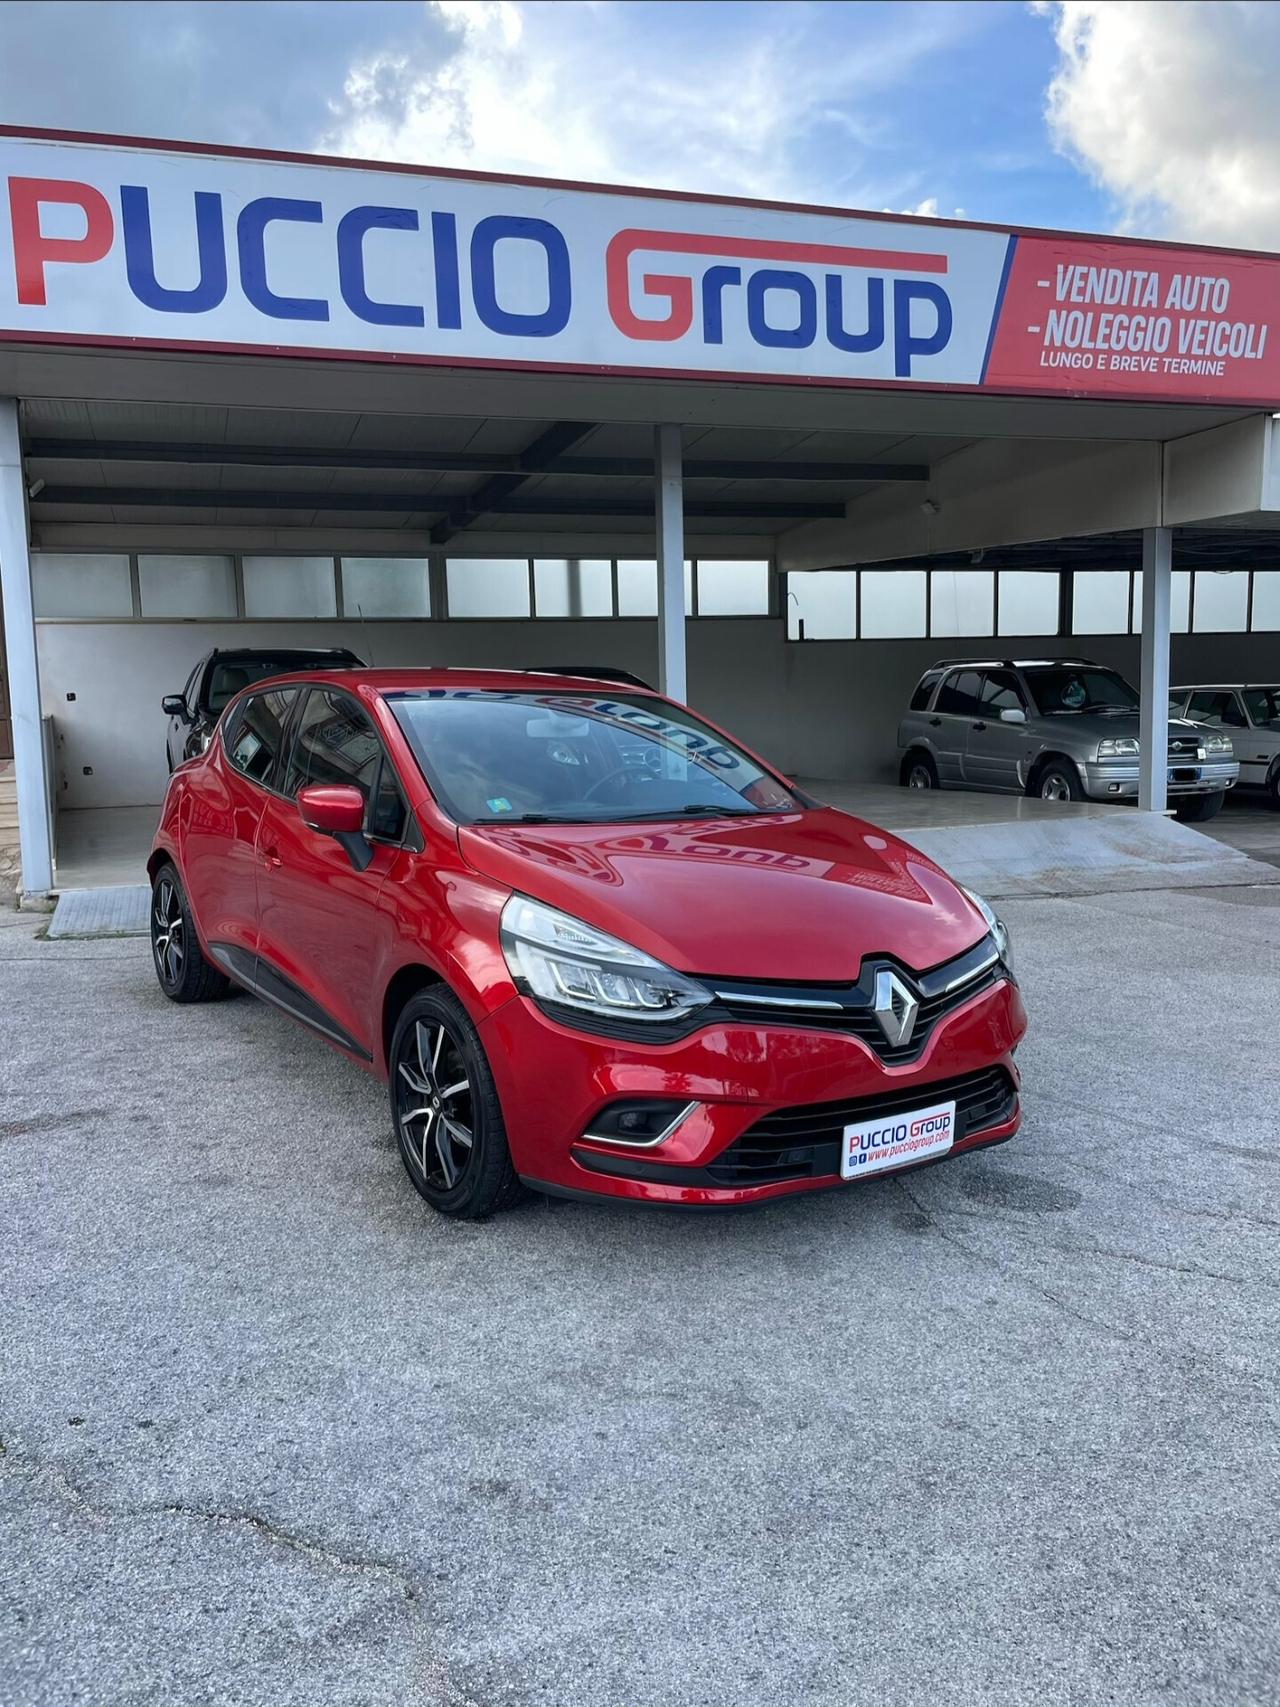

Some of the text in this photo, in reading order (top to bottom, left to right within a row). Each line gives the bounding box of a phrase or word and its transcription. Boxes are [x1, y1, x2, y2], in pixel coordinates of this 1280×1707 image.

[8, 176, 572, 338] PUCCIO
[1056, 264, 1159, 309] VENDITA
[1164, 274, 1230, 314] AUTO
[1043, 309, 1172, 354] NOLEGGIO
[1178, 318, 1267, 359] VEICOLI
[1040, 351, 1226, 376] LUNGO E BREVE TERMINE
[849, 1124, 907, 1154] PUCCIO
[867, 1130, 950, 1162] www.pucciogroup.com
